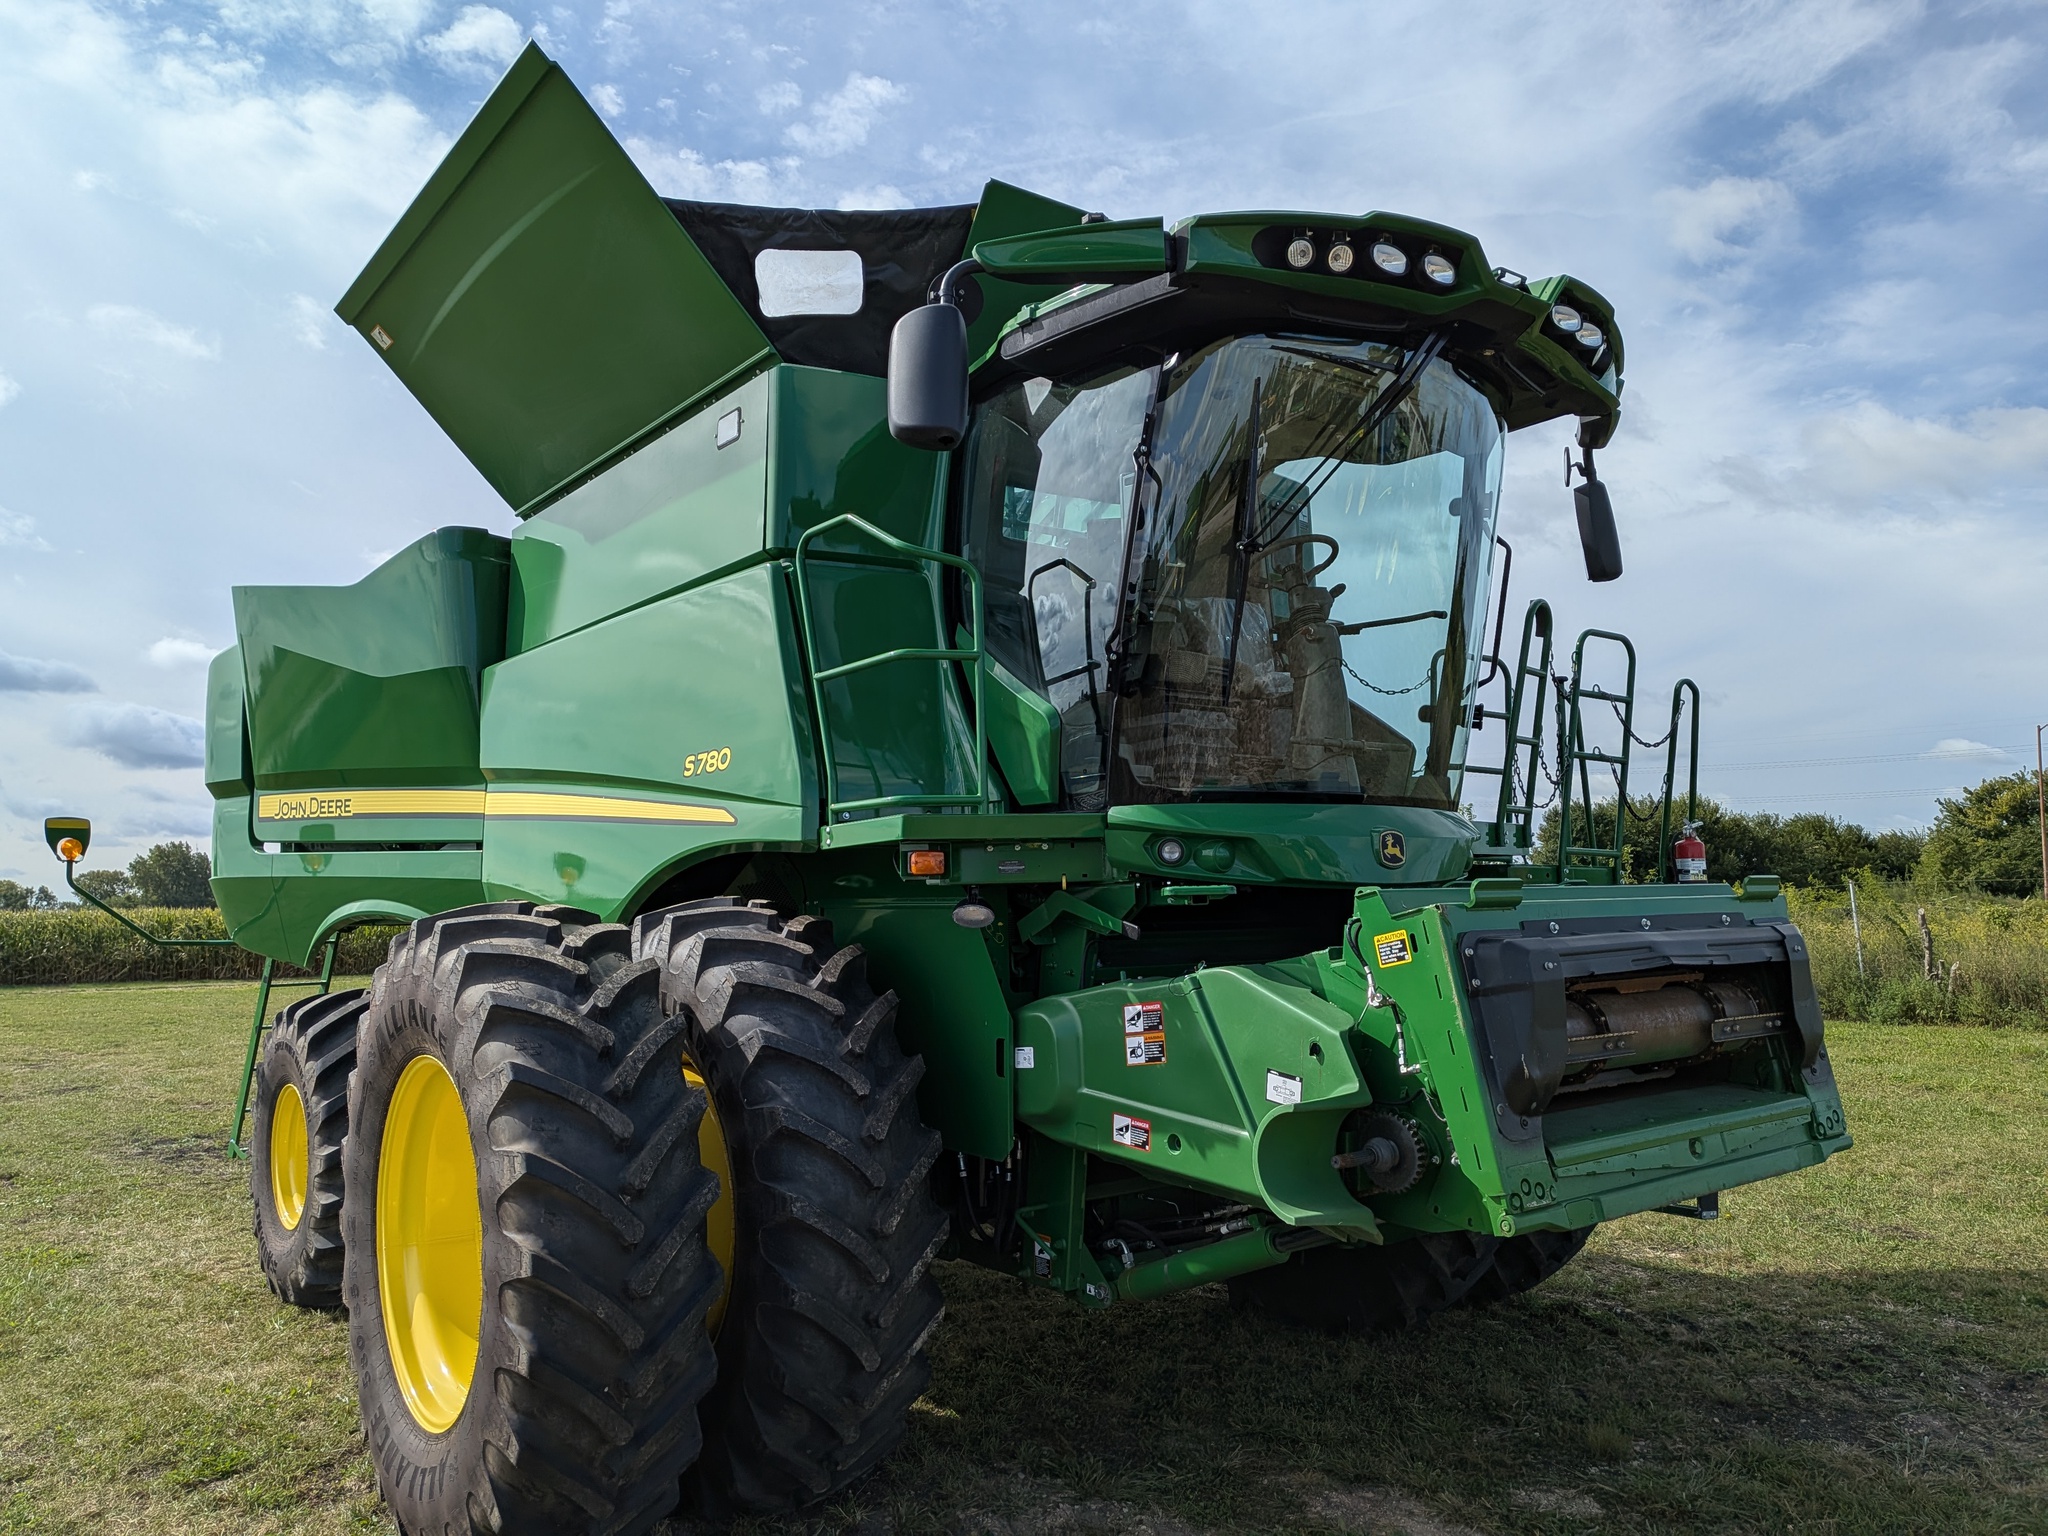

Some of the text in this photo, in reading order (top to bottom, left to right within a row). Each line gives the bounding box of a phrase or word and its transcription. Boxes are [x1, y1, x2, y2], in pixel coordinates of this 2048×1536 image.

[683, 746, 731, 778] S780
[274, 797, 352, 817] JOHN DEERE
[1380, 932, 1405, 941] CAUTION
[375, 998, 448, 1062] ALLIANCE
[370, 1404, 450, 1502] ALLIANCE
